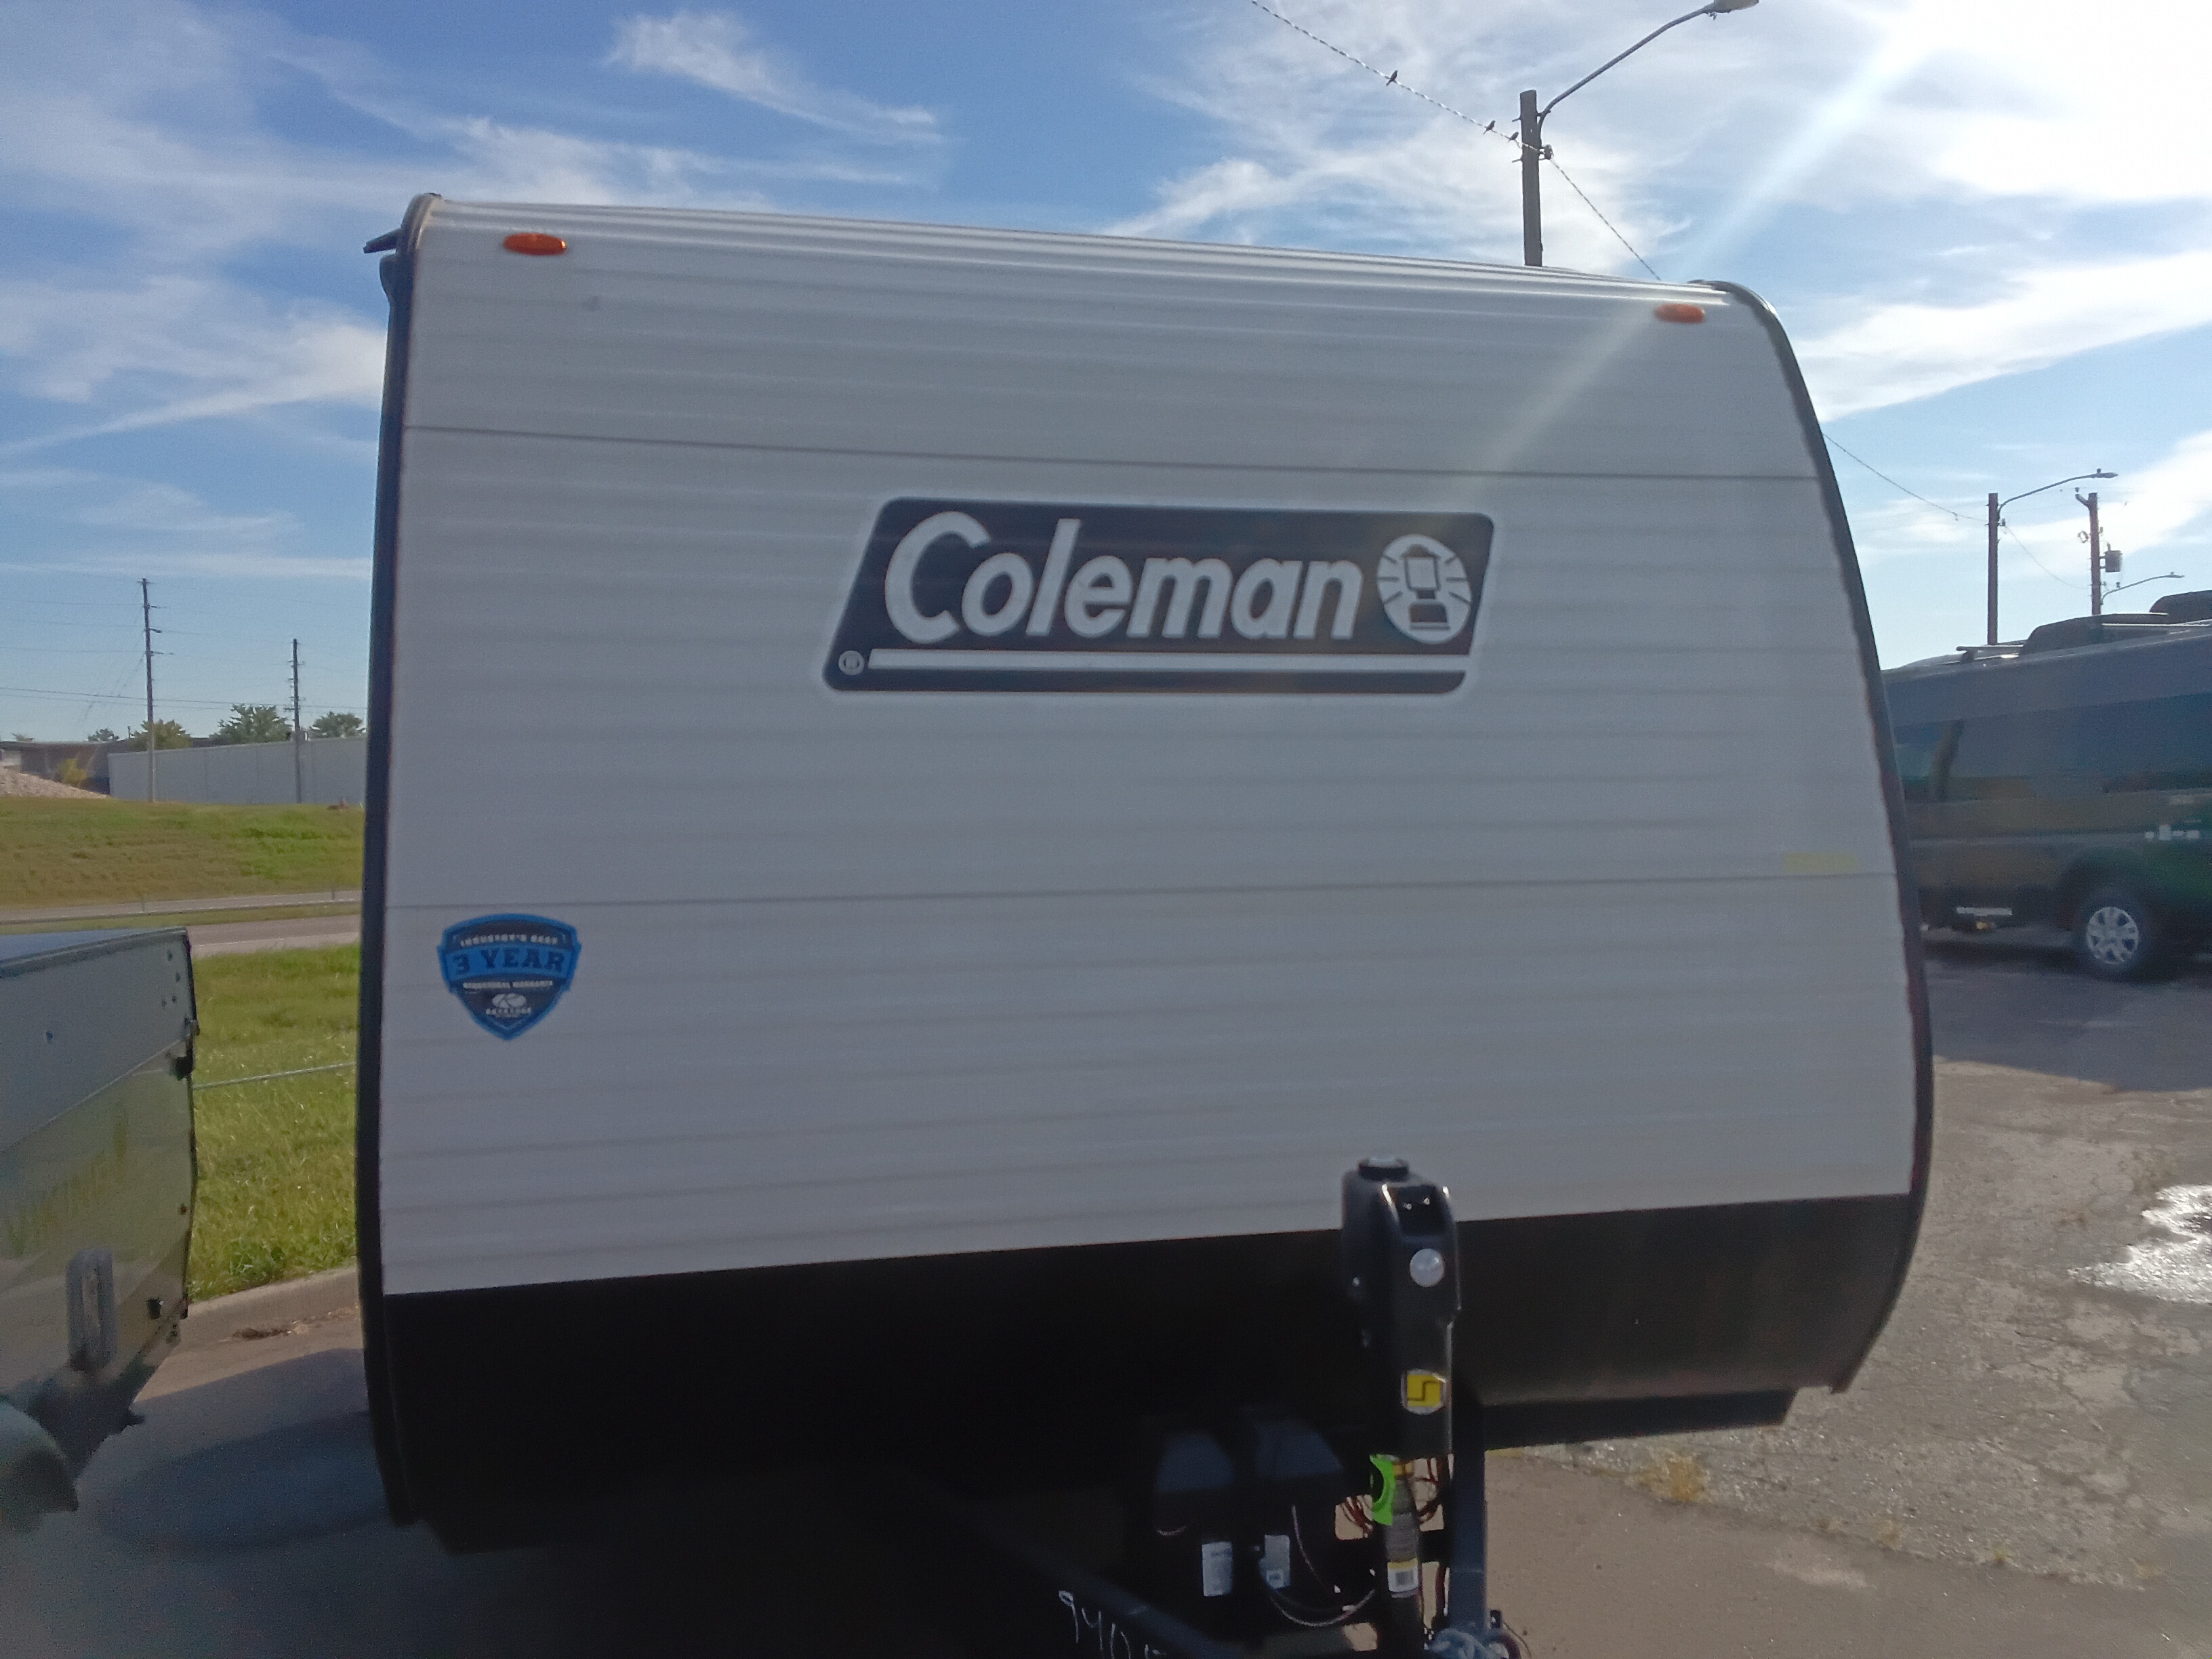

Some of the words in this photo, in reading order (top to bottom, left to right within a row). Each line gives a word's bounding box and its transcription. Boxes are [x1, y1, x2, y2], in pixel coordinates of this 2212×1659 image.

[884, 510, 1364, 644] Coleman
[453, 953, 470, 975] 3
[480, 948, 566, 972] YEAR
